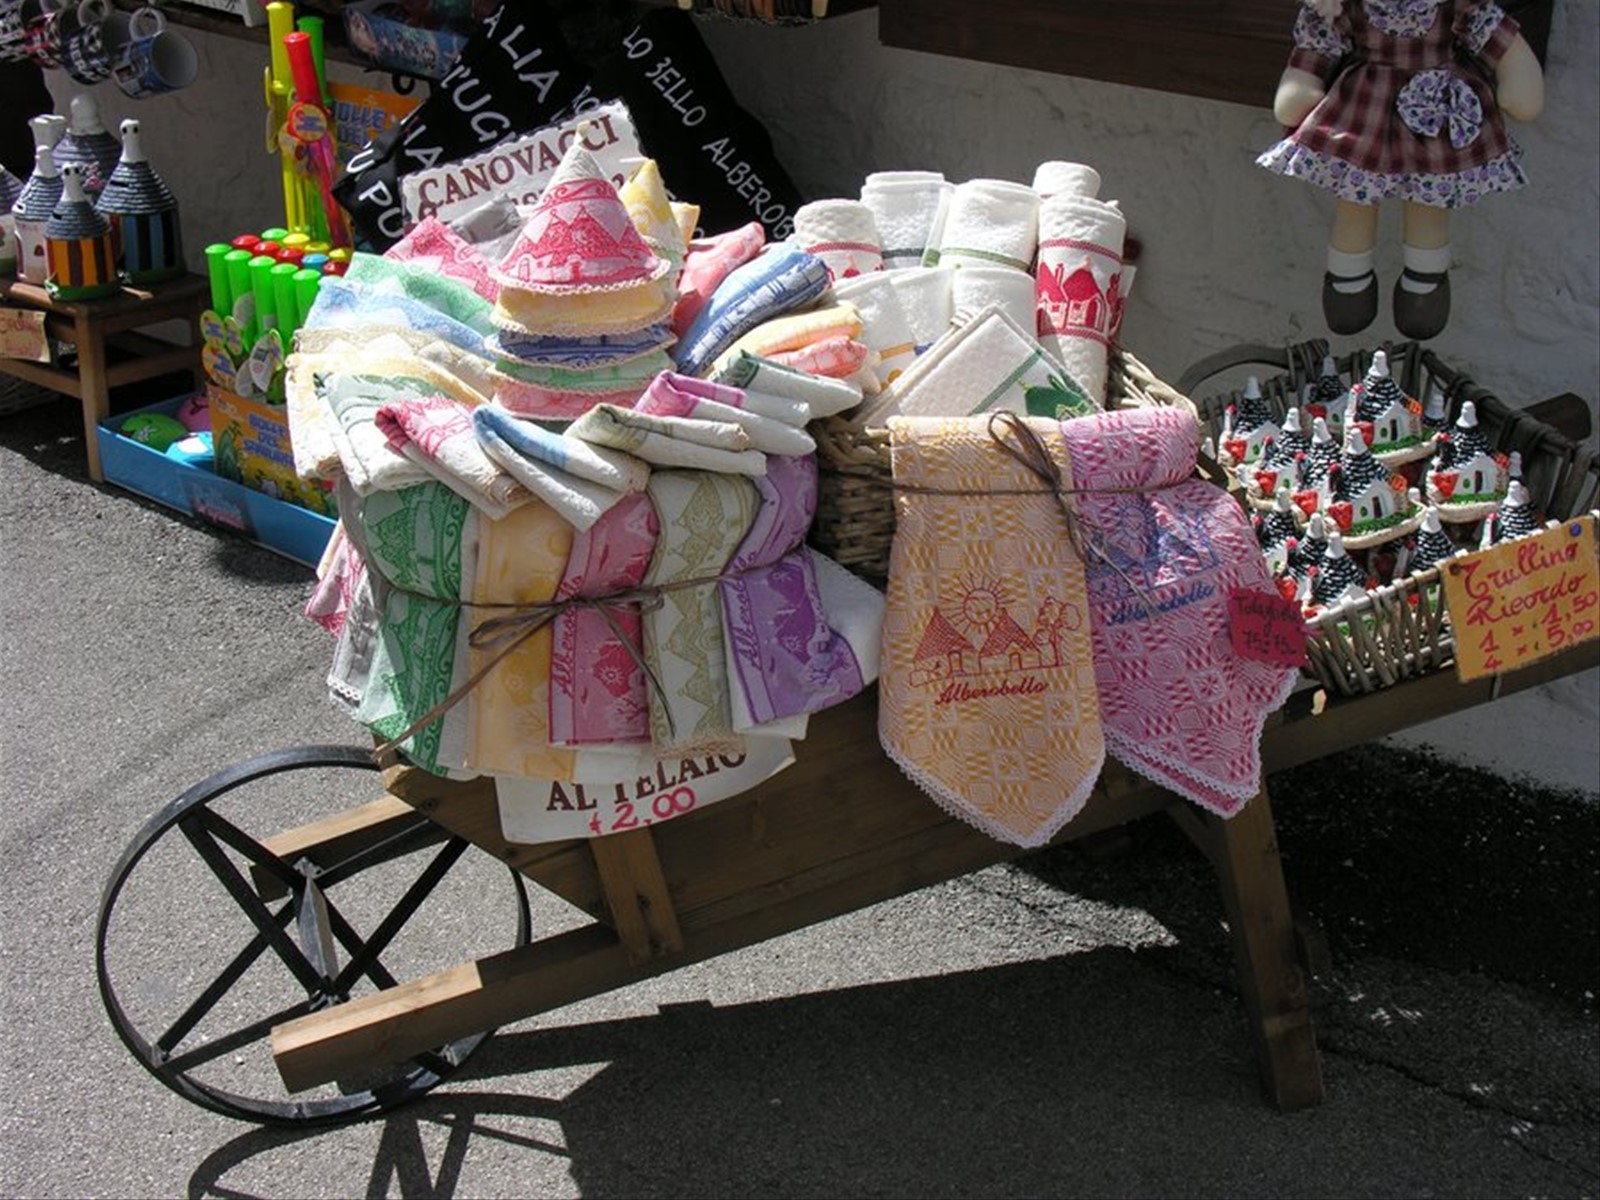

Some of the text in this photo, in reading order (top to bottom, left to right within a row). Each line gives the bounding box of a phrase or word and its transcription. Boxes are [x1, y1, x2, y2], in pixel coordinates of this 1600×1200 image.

[483, 5, 560, 103] ALIA
[418, 114, 620, 208] CANOVACCI
[702, 137, 795, 239] ALBEROB
[551, 575, 583, 698] Alberollo
[723, 551, 761, 671] Alberoblo
[1106, 582, 1217, 626] Albeobello
[934, 675, 1049, 705] Alberobello
[546, 780, 598, 811] AL
